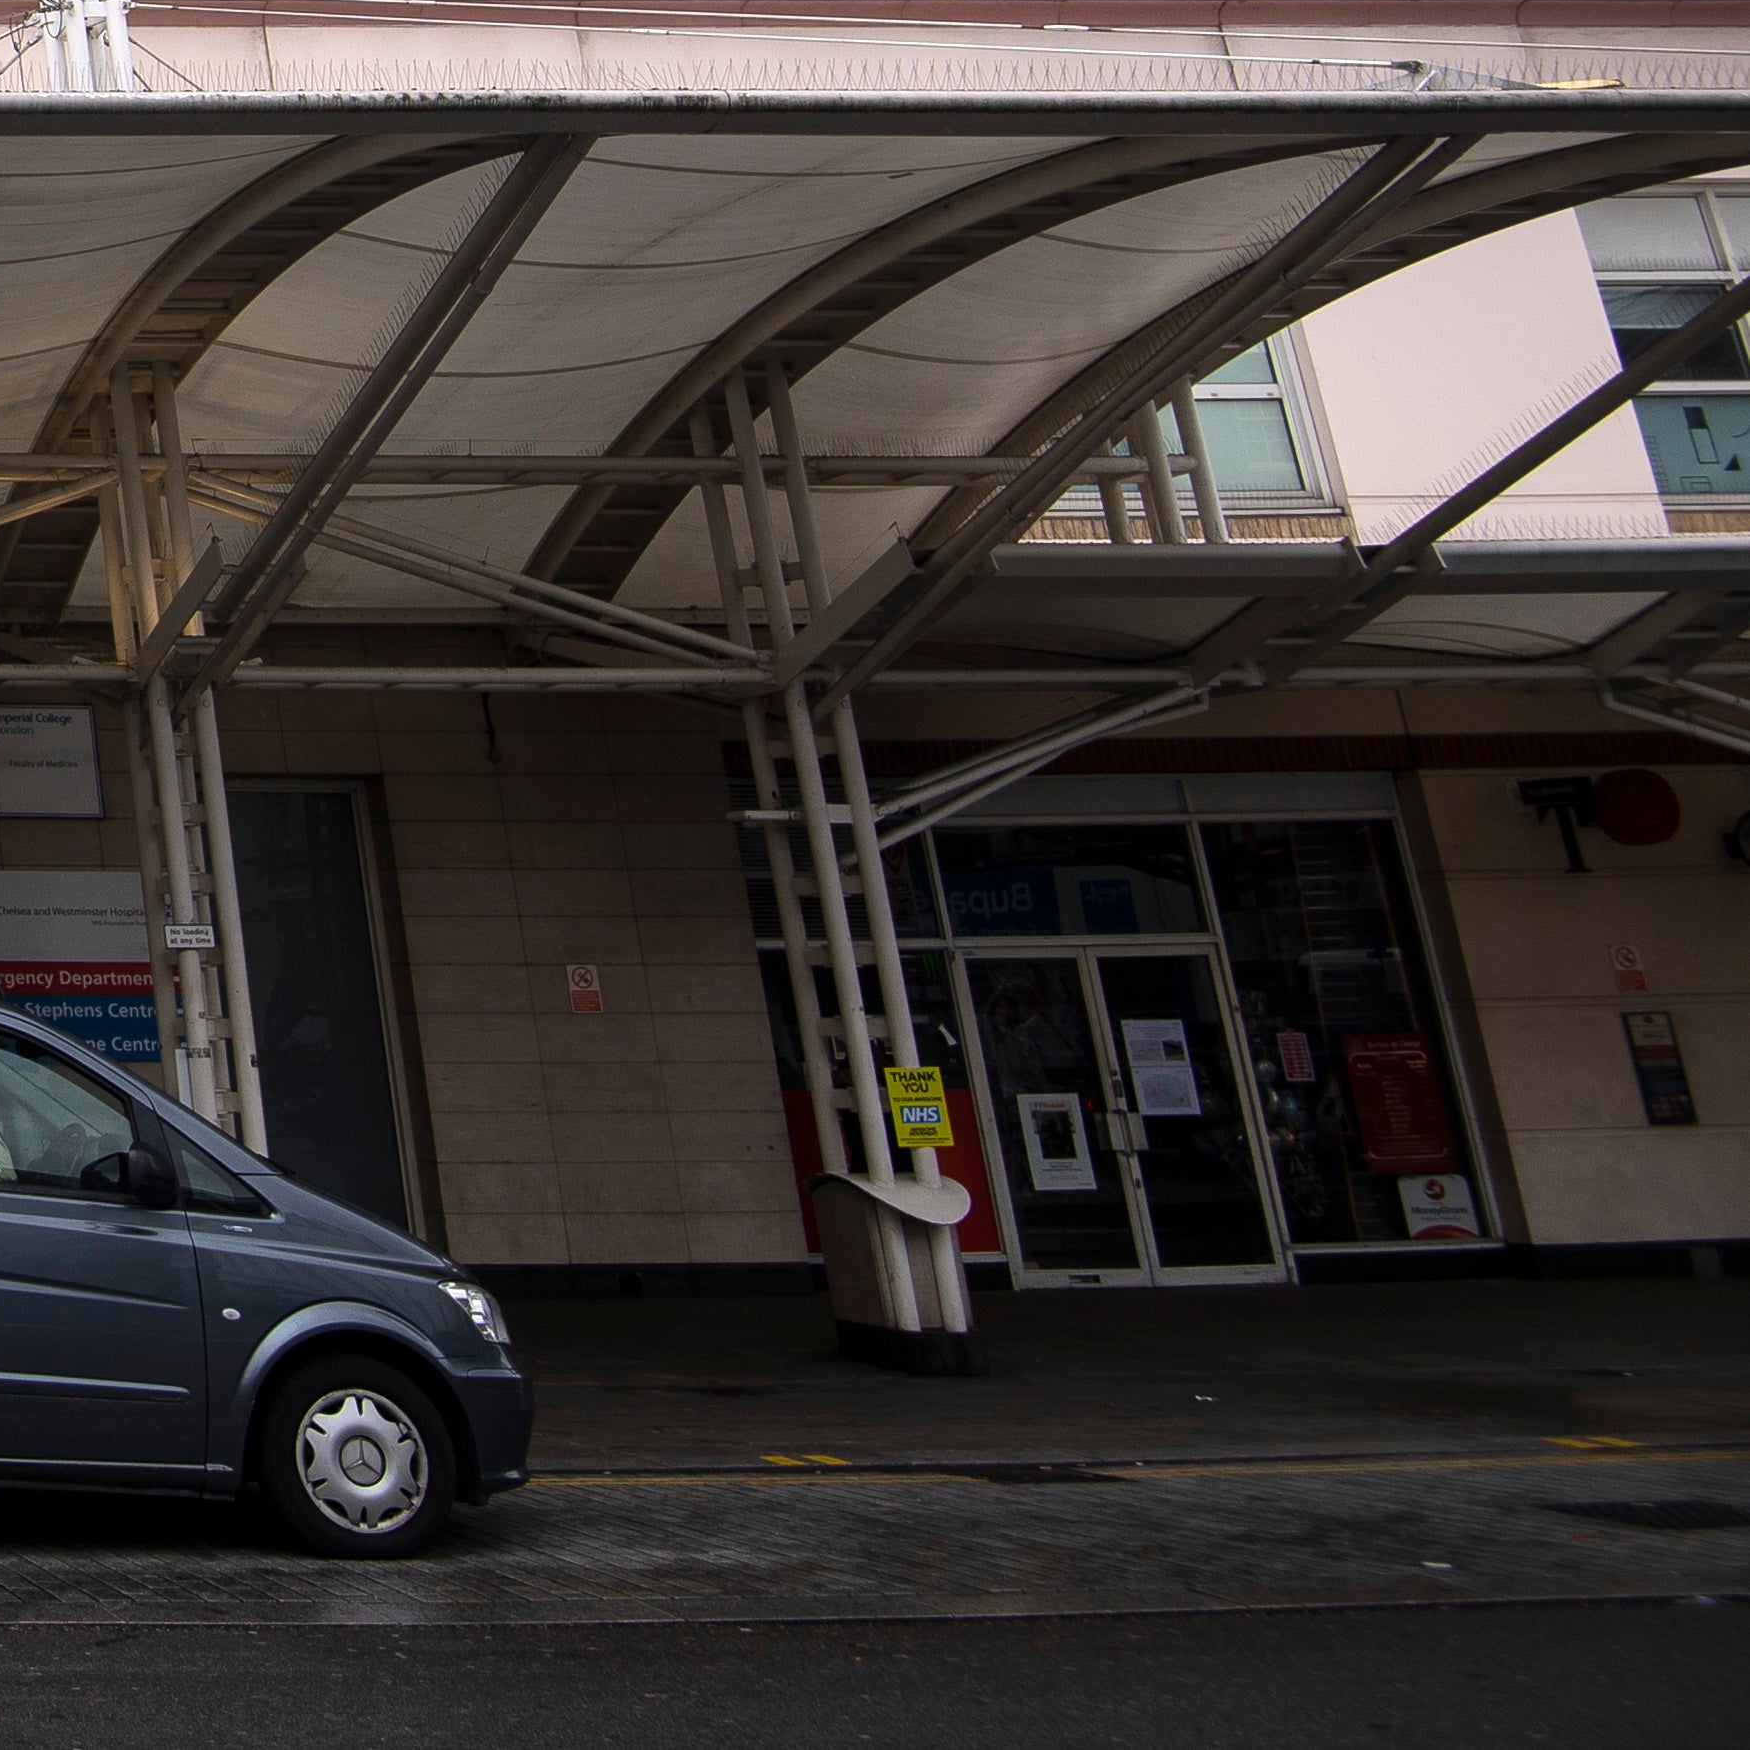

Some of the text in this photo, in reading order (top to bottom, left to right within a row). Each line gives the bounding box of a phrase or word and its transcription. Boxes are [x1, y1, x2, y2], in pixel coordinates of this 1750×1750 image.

[35, 713, 73, 726] College
[33, 906, 50, 916] and
[51, 906, 107, 917] Westminster
[109, 907, 146, 919] Hospita
[182, 928, 209, 937] loading
[179, 938, 194, 946] any
[195, 936, 211, 944] time
[59, 970, 154, 988] Departmen
[25, 1002, 157, 1020] Stephens Centr
[889, 1071, 937, 1082] THANK
[901, 1082, 930, 1093] YOU
[902, 1106, 939, 1122] NHS
